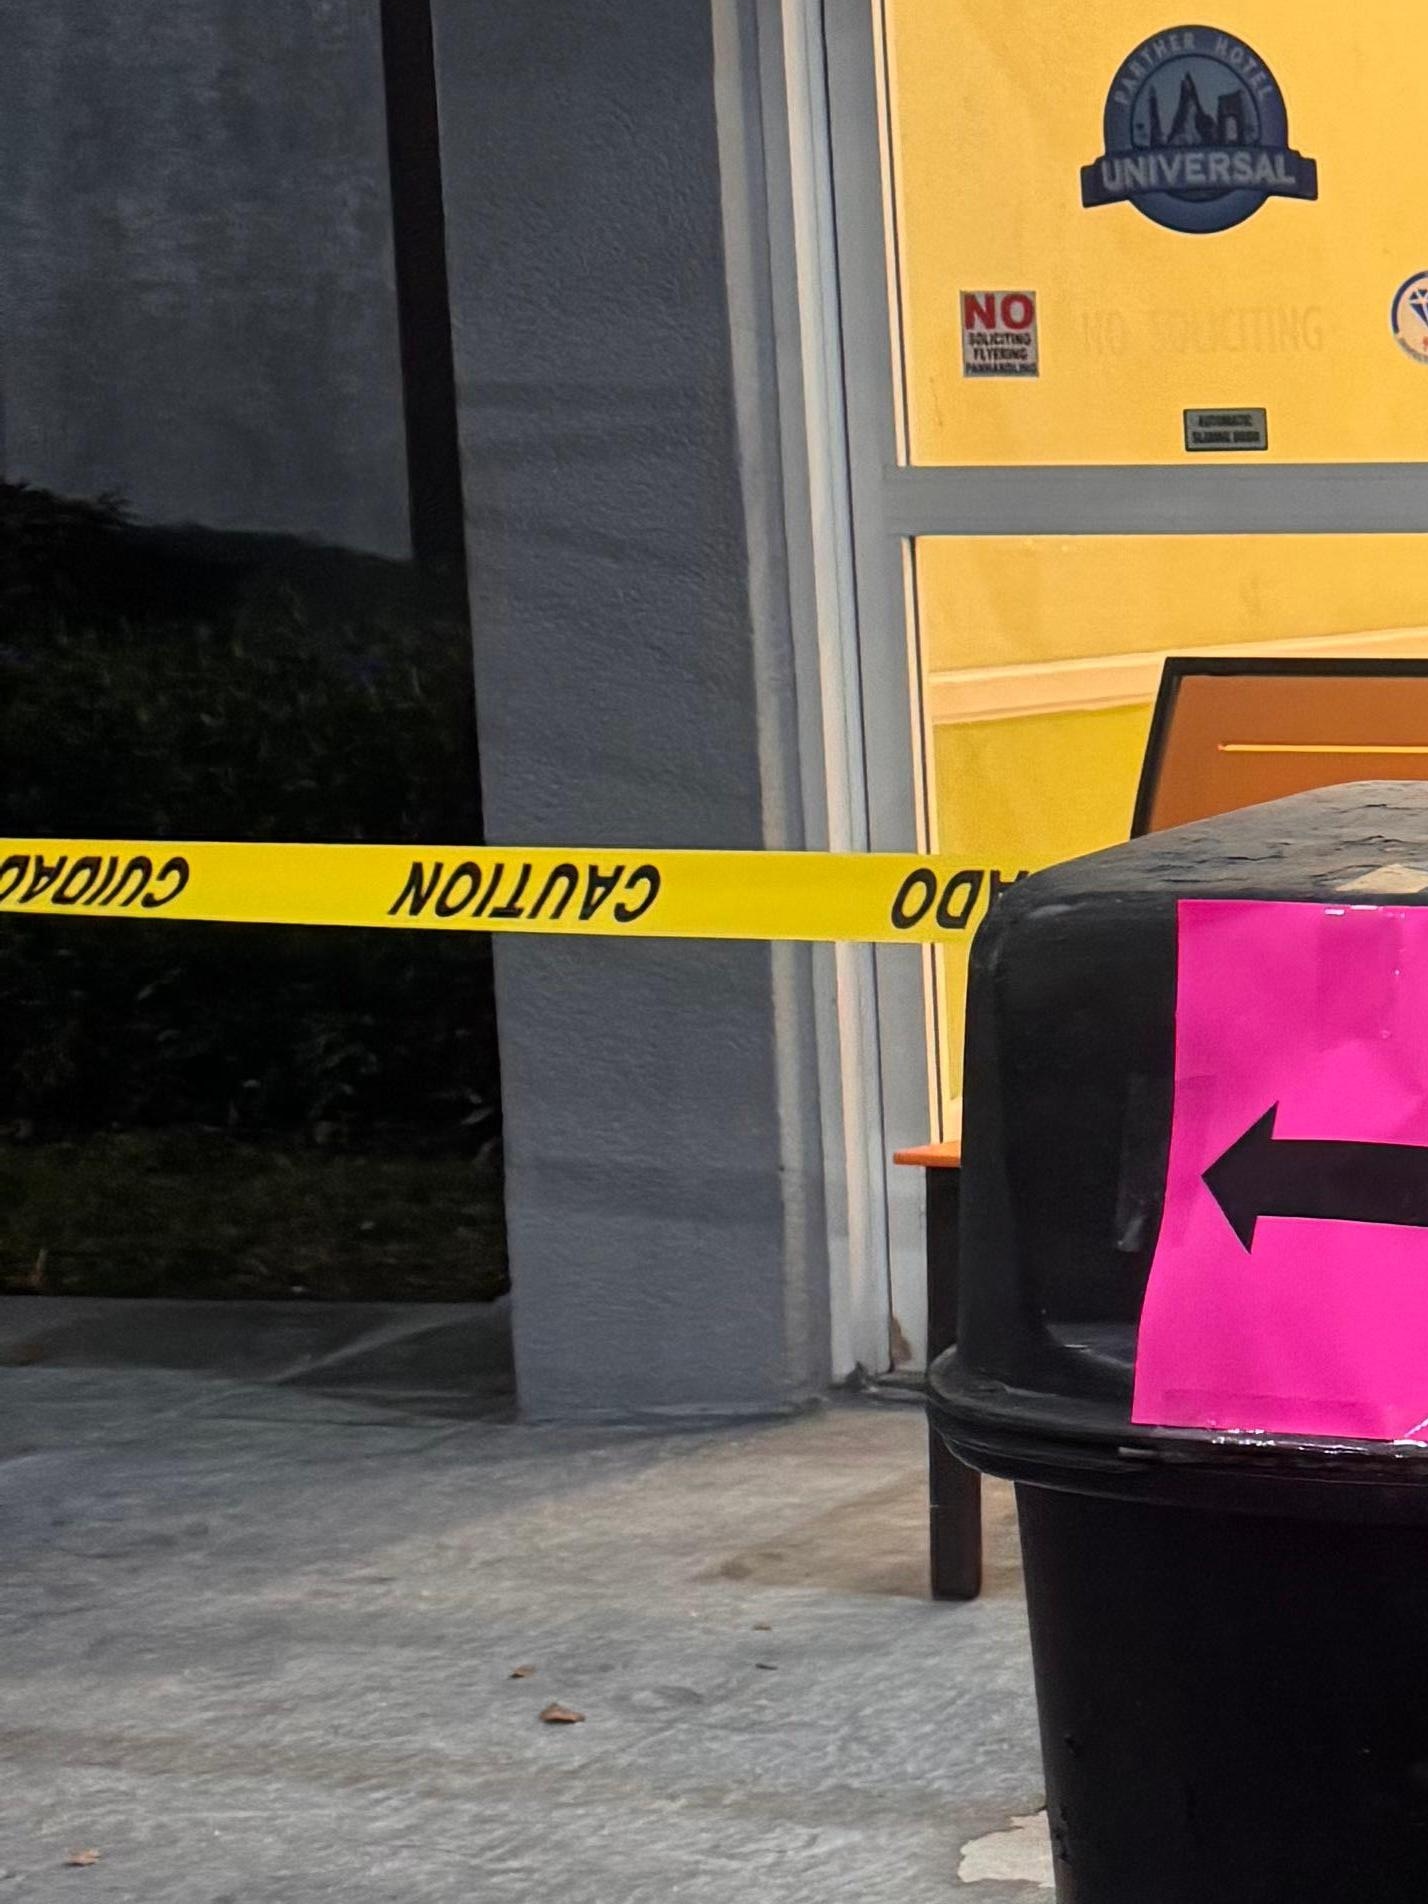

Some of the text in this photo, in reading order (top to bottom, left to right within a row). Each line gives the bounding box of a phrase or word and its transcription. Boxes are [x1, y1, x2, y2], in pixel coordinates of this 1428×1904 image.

[1215, 36, 1274, 101] HOTEL
[1101, 151, 1297, 193] UNIVERSAL
[964, 292, 1034, 330] NO
[968, 331, 1032, 347] SOLICITING
[0, 854, 662, 923] CAUTION CUIDAD
